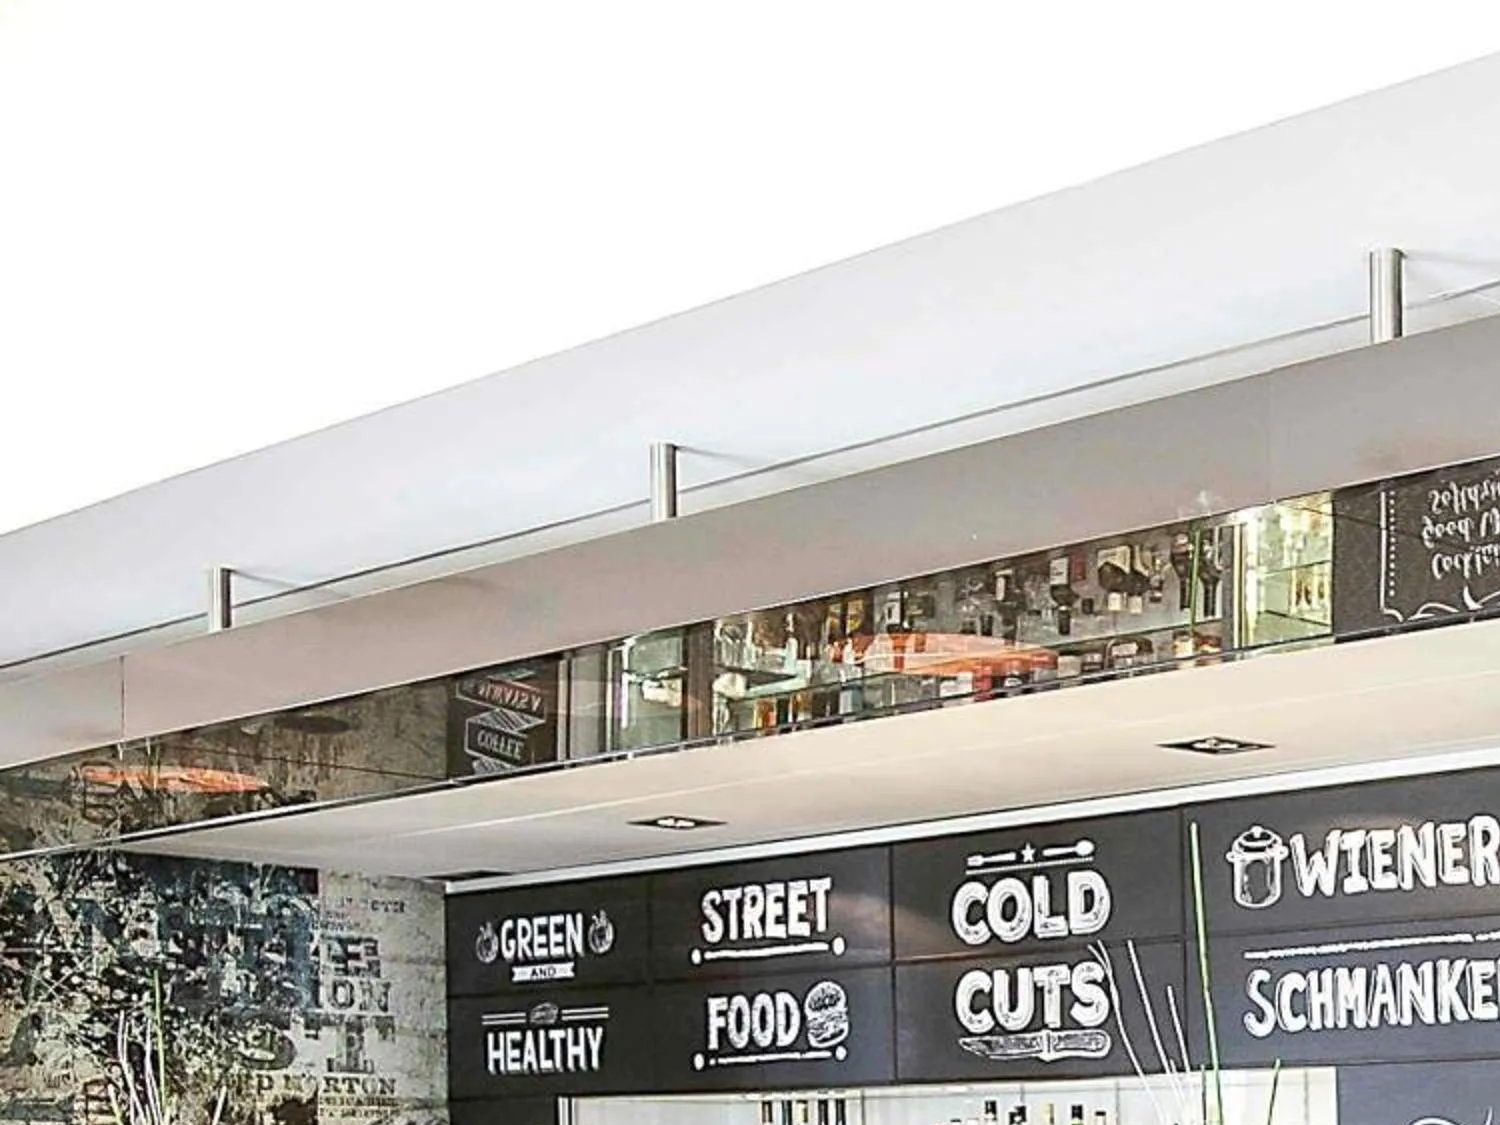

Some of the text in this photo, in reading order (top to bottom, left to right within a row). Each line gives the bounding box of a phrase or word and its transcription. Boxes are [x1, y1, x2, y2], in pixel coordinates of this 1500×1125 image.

[501, 912, 585, 961] GREEN
[702, 877, 832, 944] STREET
[951, 869, 1111, 945] COLD
[530, 965, 557, 978] AND
[954, 961, 1111, 1034] CUTS
[487, 1026, 604, 1075] HEALTHY
[707, 992, 801, 1052] FOOD
